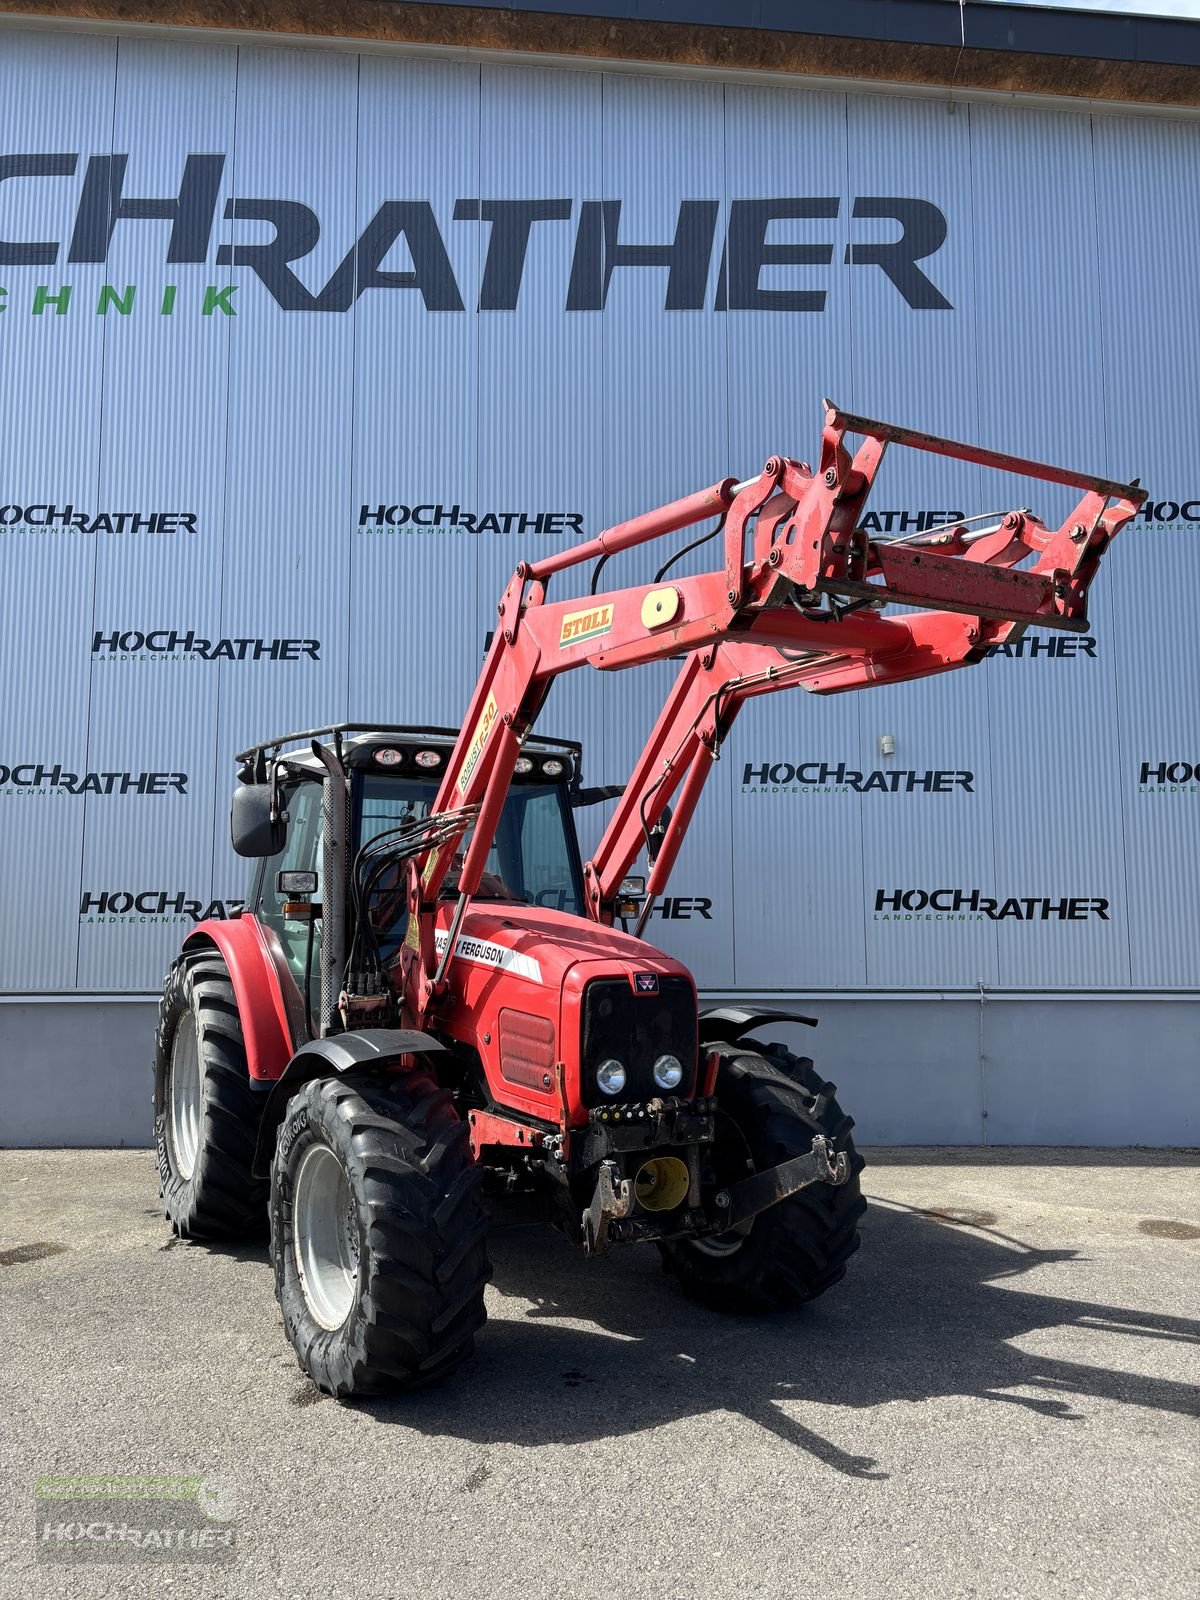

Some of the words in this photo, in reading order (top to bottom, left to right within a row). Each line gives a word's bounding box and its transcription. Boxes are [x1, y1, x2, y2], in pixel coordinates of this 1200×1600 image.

[0, 285, 240, 316] HNIK
[357, 527, 463, 535] LANDTECHNIK
[358, 504, 585, 534] HOCHRATHER
[1126, 523, 1200, 531] LANDTEC
[561, 608, 610, 640] STOLL
[92, 631, 321, 661] HOCHRATHER
[460, 739, 481, 787] ROBUST
[742, 762, 976, 793] HOCHRATHER
[1139, 761, 1200, 784] HO
[0, 788, 64, 796] ECHNIK
[741, 786, 849, 794] LANDTECHNIK
[874, 889, 1111, 921] HOCHRATHER
[461, 940, 505, 964] FERGUSON
